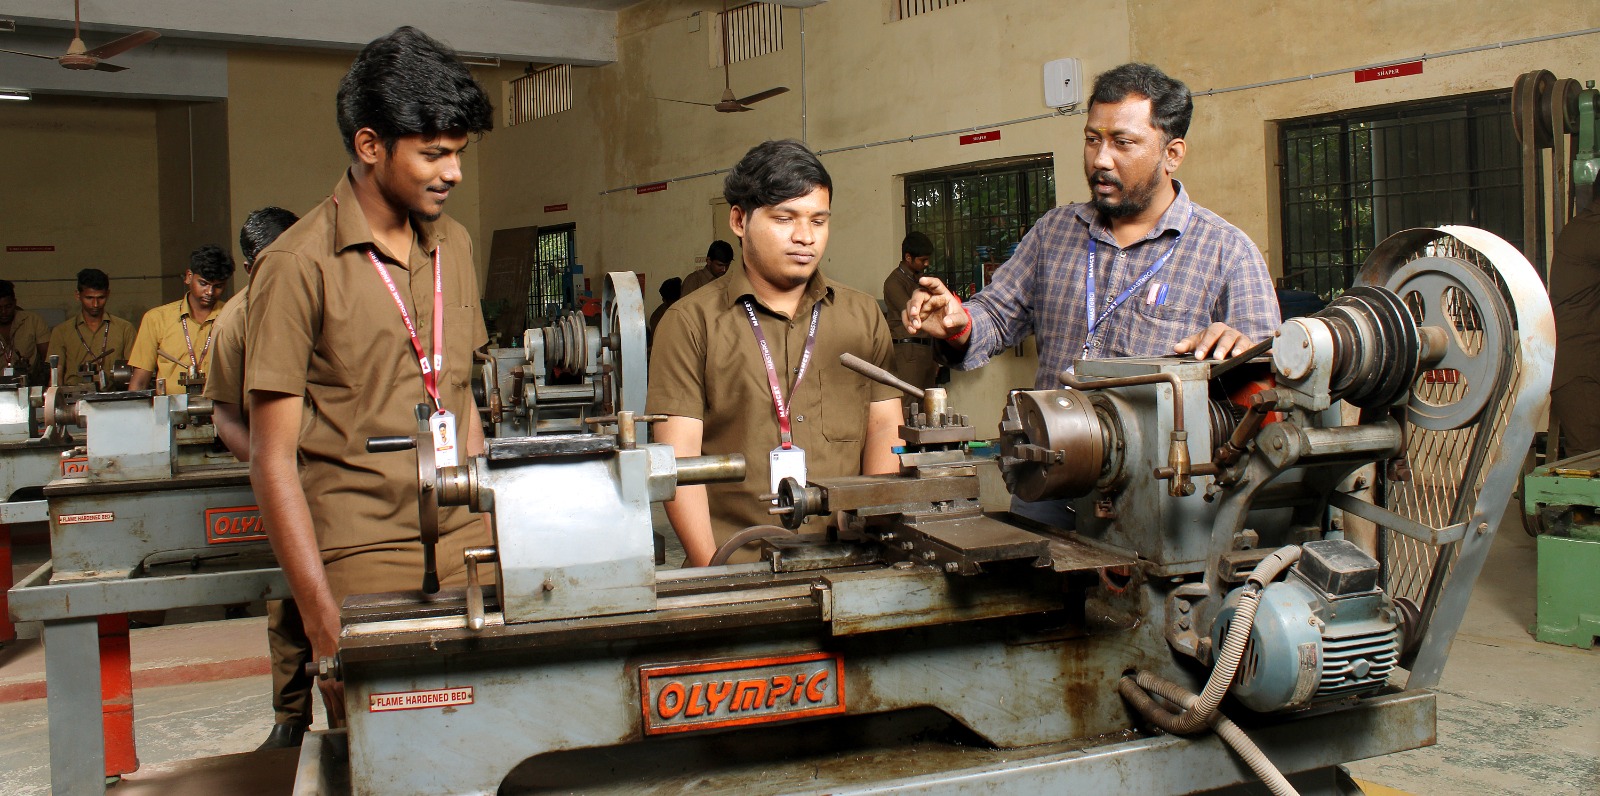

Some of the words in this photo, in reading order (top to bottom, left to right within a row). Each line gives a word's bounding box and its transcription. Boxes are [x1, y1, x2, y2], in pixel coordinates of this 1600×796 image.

[1377, 68, 1399, 77] SHAPER
[393, 291, 408, 317] COLLEGE
[798, 349, 810, 379] MAMCET
[773, 385, 786, 418] MAMCET
[377, 696, 403, 707] FLAME
[406, 693, 449, 705] HARDENED
[451, 691, 467, 701] BED
